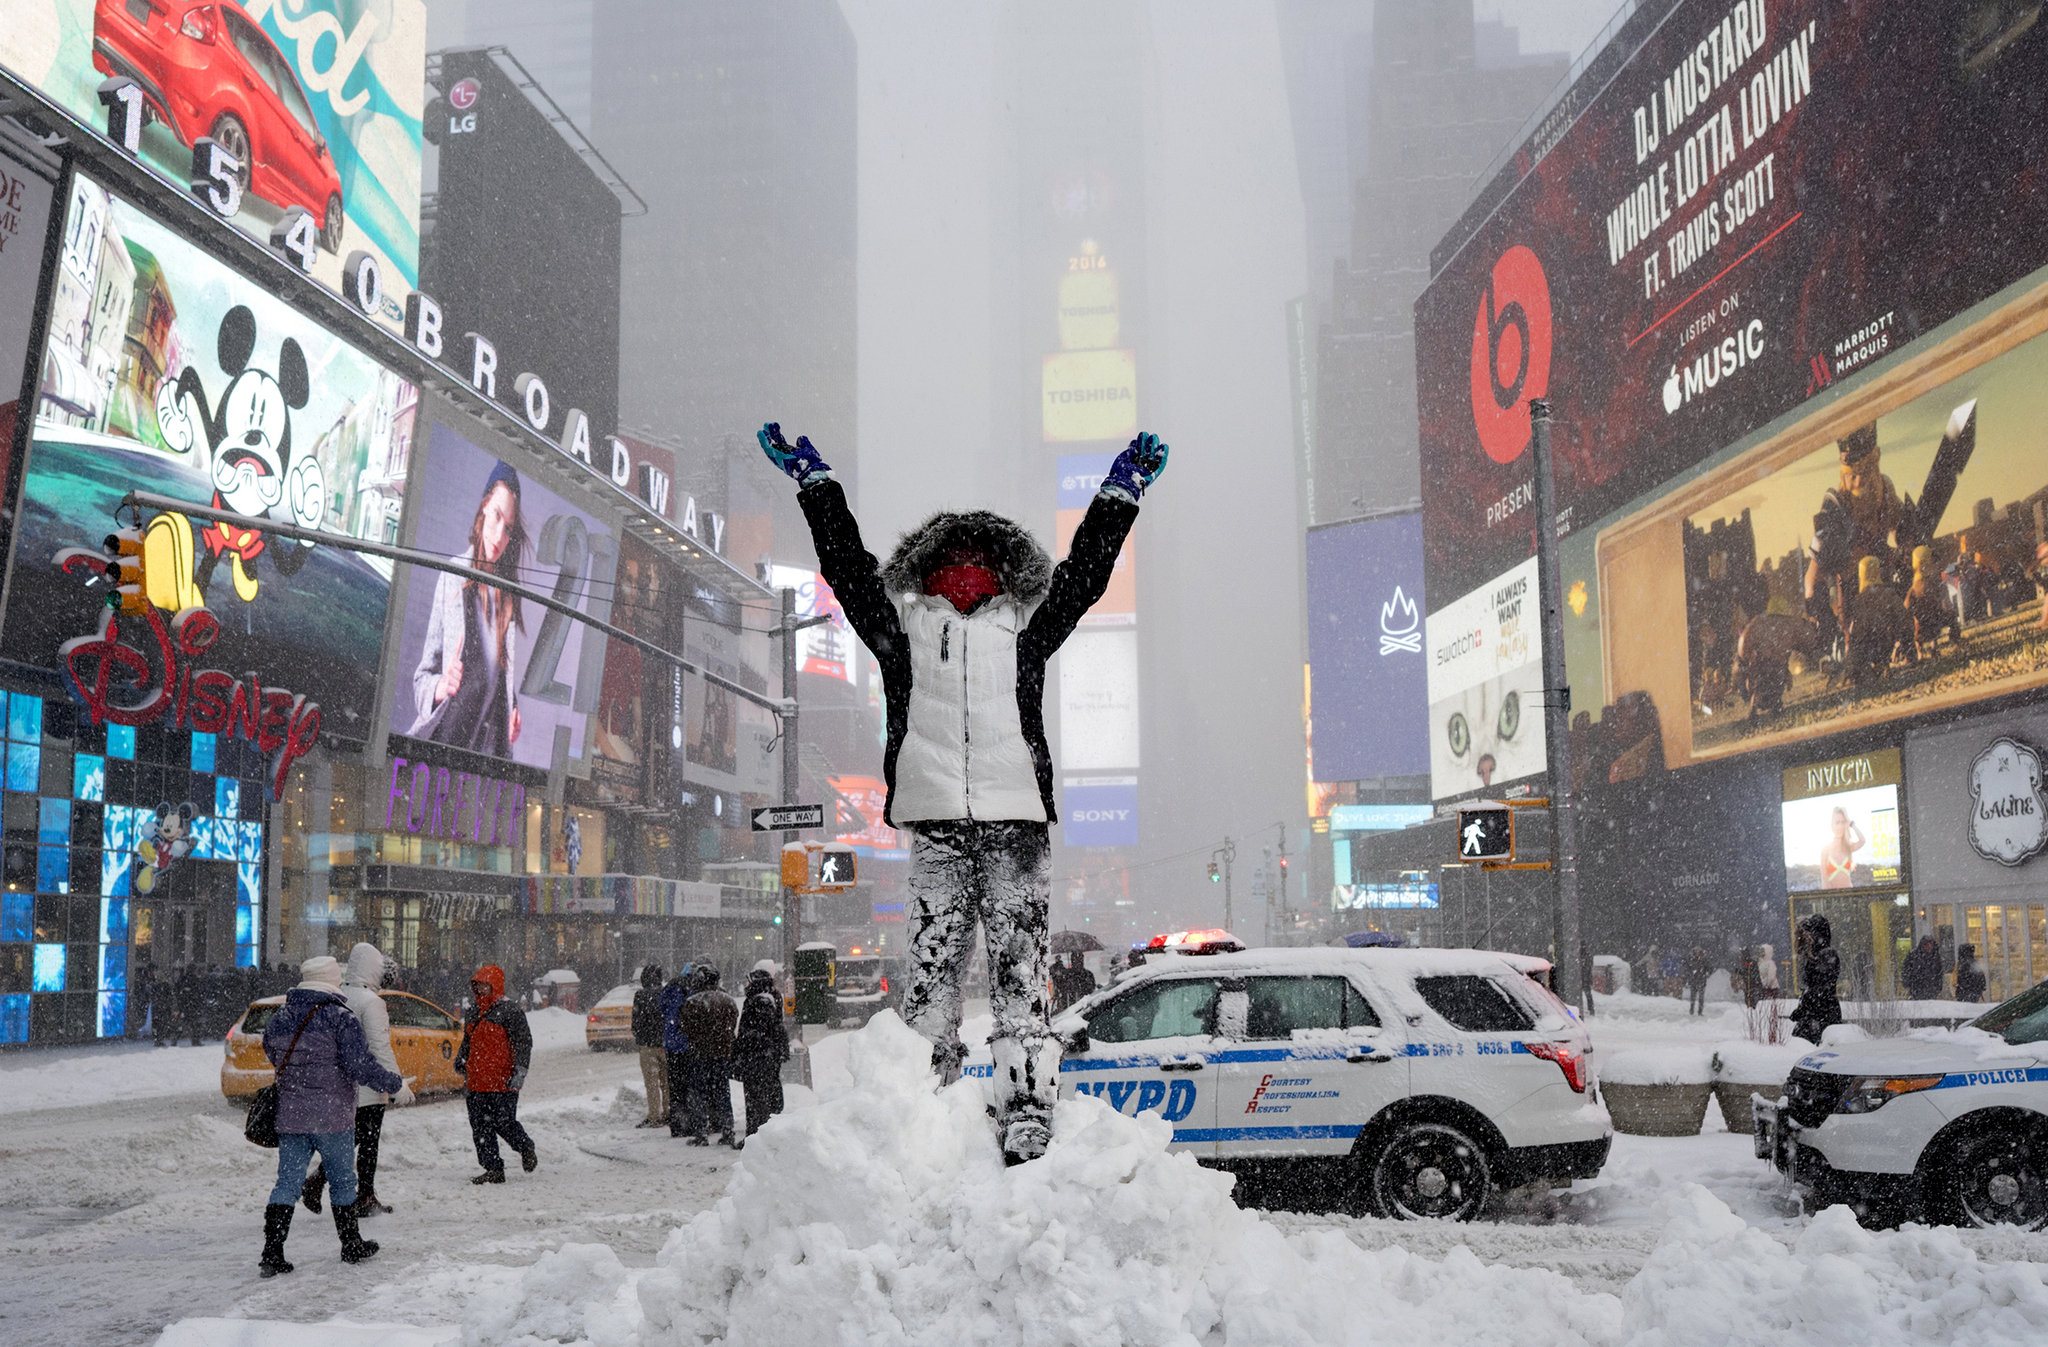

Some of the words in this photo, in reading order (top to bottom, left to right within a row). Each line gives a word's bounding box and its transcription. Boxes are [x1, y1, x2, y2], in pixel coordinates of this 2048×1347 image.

[1634, 92, 1660, 166] DJ
[1664, 0, 1767, 137] MUSTARD
[450, 115, 476, 134] LG
[1533, 88, 1577, 147] MARRIOTT
[1606, 161, 1671, 267] WHOLE
[1674, 103, 1736, 209] LOTTA
[1740, 20, 1816, 151] LOVIN'
[1644, 251, 1666, 300] FT.
[1667, 201, 1721, 279] TRAVIS
[1724, 152, 1775, 235] SCOTT
[97, 76, 382, 315] 1540
[404, 290, 726, 554] BROADWAY
[1060, 305, 1116, 318] TOSHIBA
[1680, 309, 1716, 348] LISTEN
[1720, 292, 1740, 318] ON
[1835, 311, 1895, 357] MARRIOTT
[1684, 318, 1764, 403] MUSIC
[1836, 334, 1889, 375] MARQUIS
[1048, 387, 1133, 405] TOSHIBA
[1076, 474, 1105, 489] TD
[1487, 478, 1535, 528] PRESEN
[1491, 594, 1495, 610] I
[1496, 576, 1528, 606] ALWAYS
[1498, 598, 1522, 625] WANT
[1436, 628, 1475, 666] swatch
[1807, 757, 1875, 792] INVICTA
[385, 757, 525, 848] FOREVER
[772, 812, 793, 824] ONE
[795, 810, 816, 823] WAY
[1072, 809, 1130, 822] SONY
[1672, 873, 1720, 888] VORNADO
[960, 1065, 985, 1078] ICE
[1261, 1074, 1312, 1087] COURTESY
[1967, 1069, 2026, 1086] POLICE
[1245, 1101, 1292, 1114] RESPECT
[1253, 1087, 1340, 1100] PROFESSIONALISM
